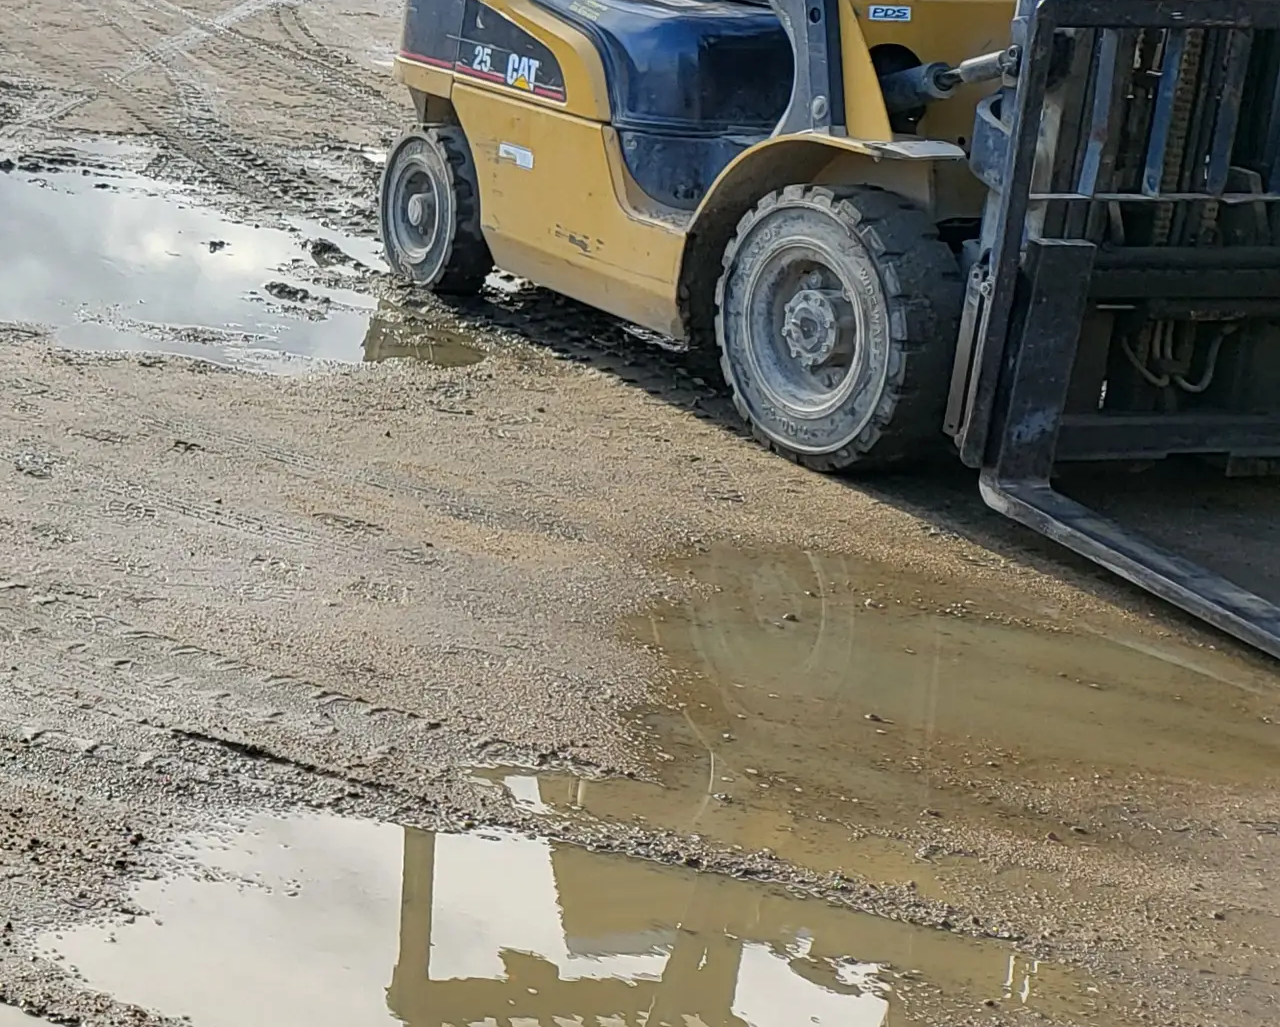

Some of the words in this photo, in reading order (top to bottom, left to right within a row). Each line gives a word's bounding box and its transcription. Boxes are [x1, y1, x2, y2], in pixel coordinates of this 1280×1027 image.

[872, 7, 909, 19] PDS
[473, 45, 492, 73] 25
[506, 53, 540, 92] CAT
